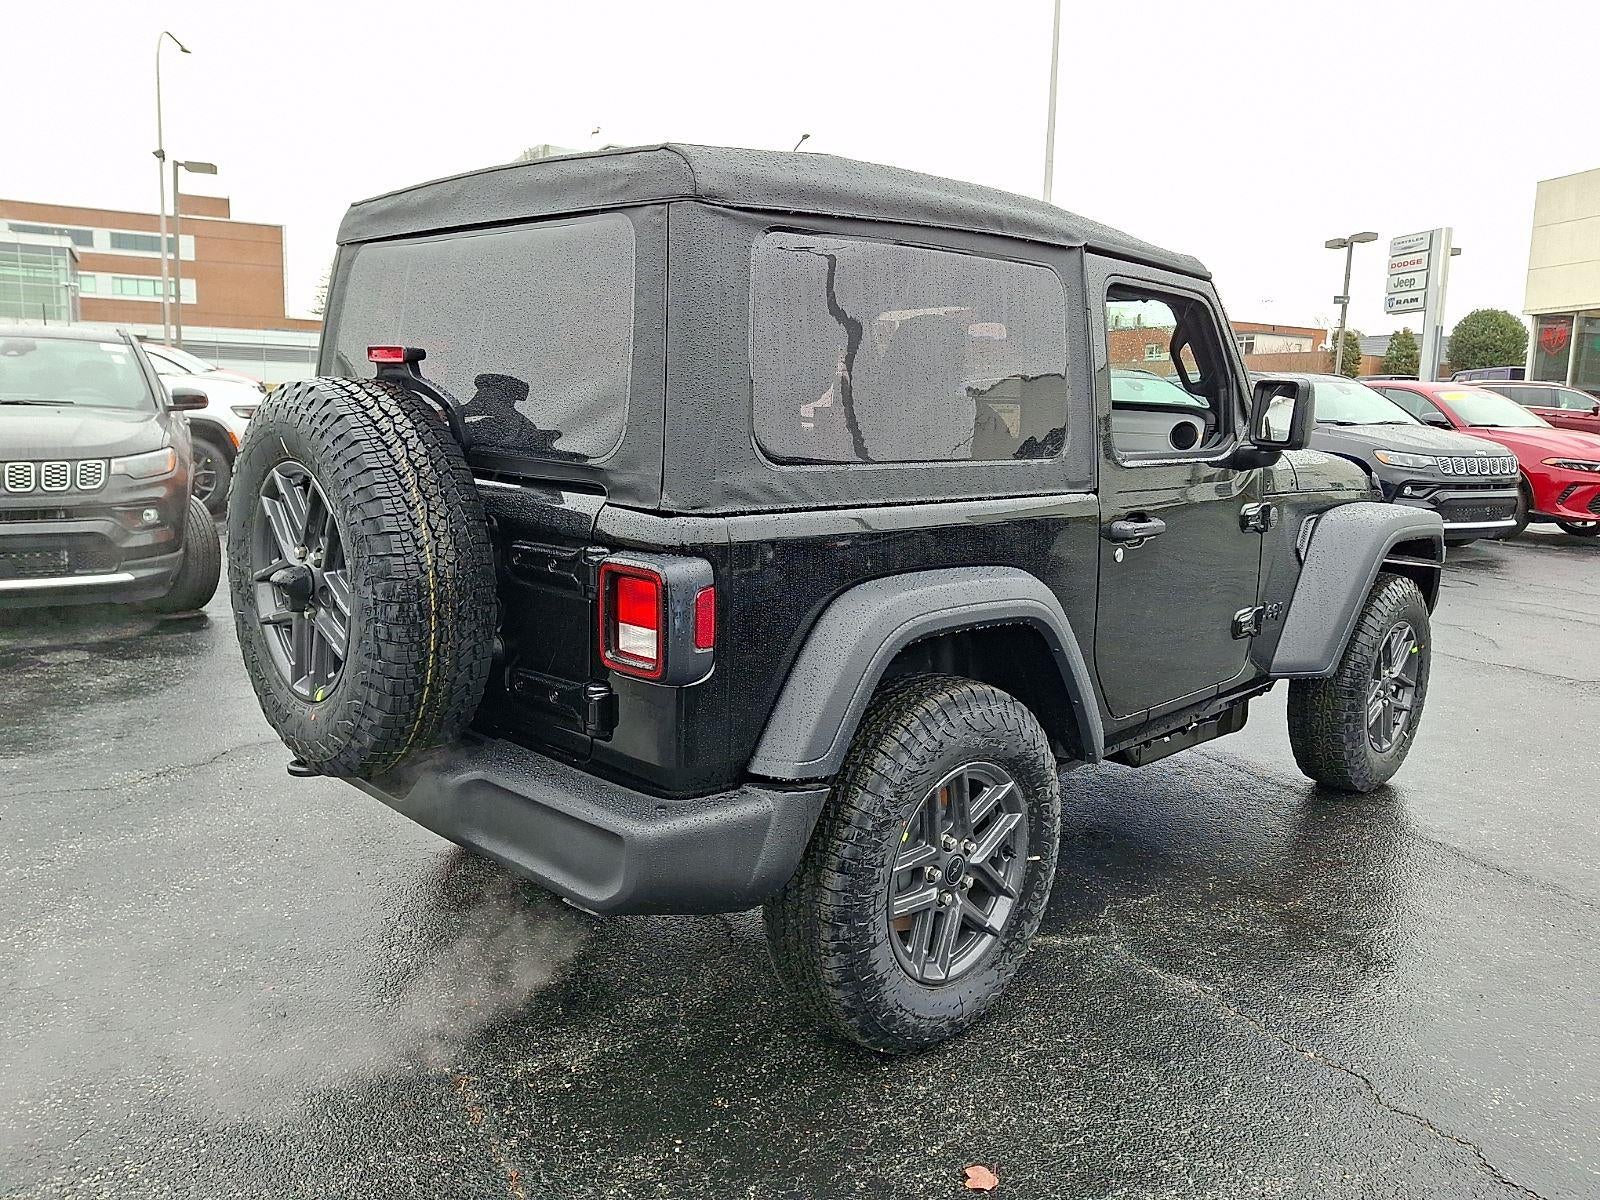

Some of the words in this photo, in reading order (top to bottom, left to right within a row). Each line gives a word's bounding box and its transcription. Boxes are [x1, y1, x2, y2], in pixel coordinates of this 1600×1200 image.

[1393, 236, 1424, 246] CHRYSLER
[1390, 258, 1423, 269] DODGE
[1393, 277, 1416, 288] Jeep
[1395, 297, 1419, 306] RAM
